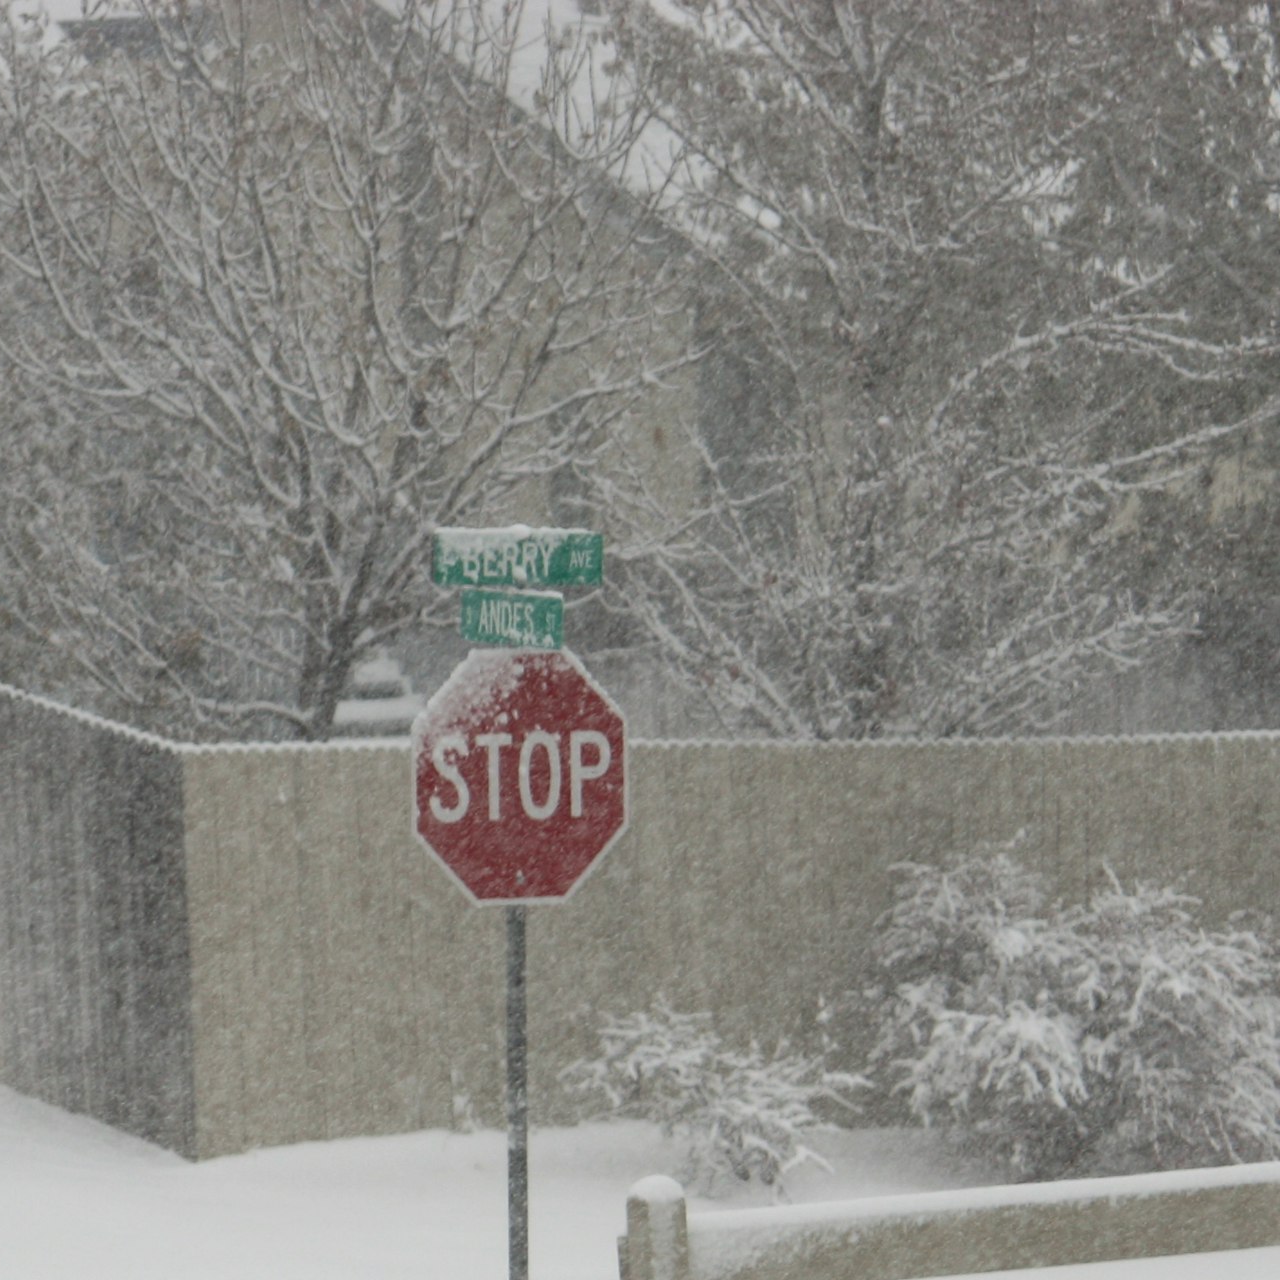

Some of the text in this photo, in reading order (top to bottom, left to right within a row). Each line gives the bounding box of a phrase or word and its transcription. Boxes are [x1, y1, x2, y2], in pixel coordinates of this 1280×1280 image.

[462, 542, 554, 578] BERRY
[569, 550, 593, 569] AVE
[478, 599, 535, 636] ANDES
[429, 730, 612, 823] STOP
